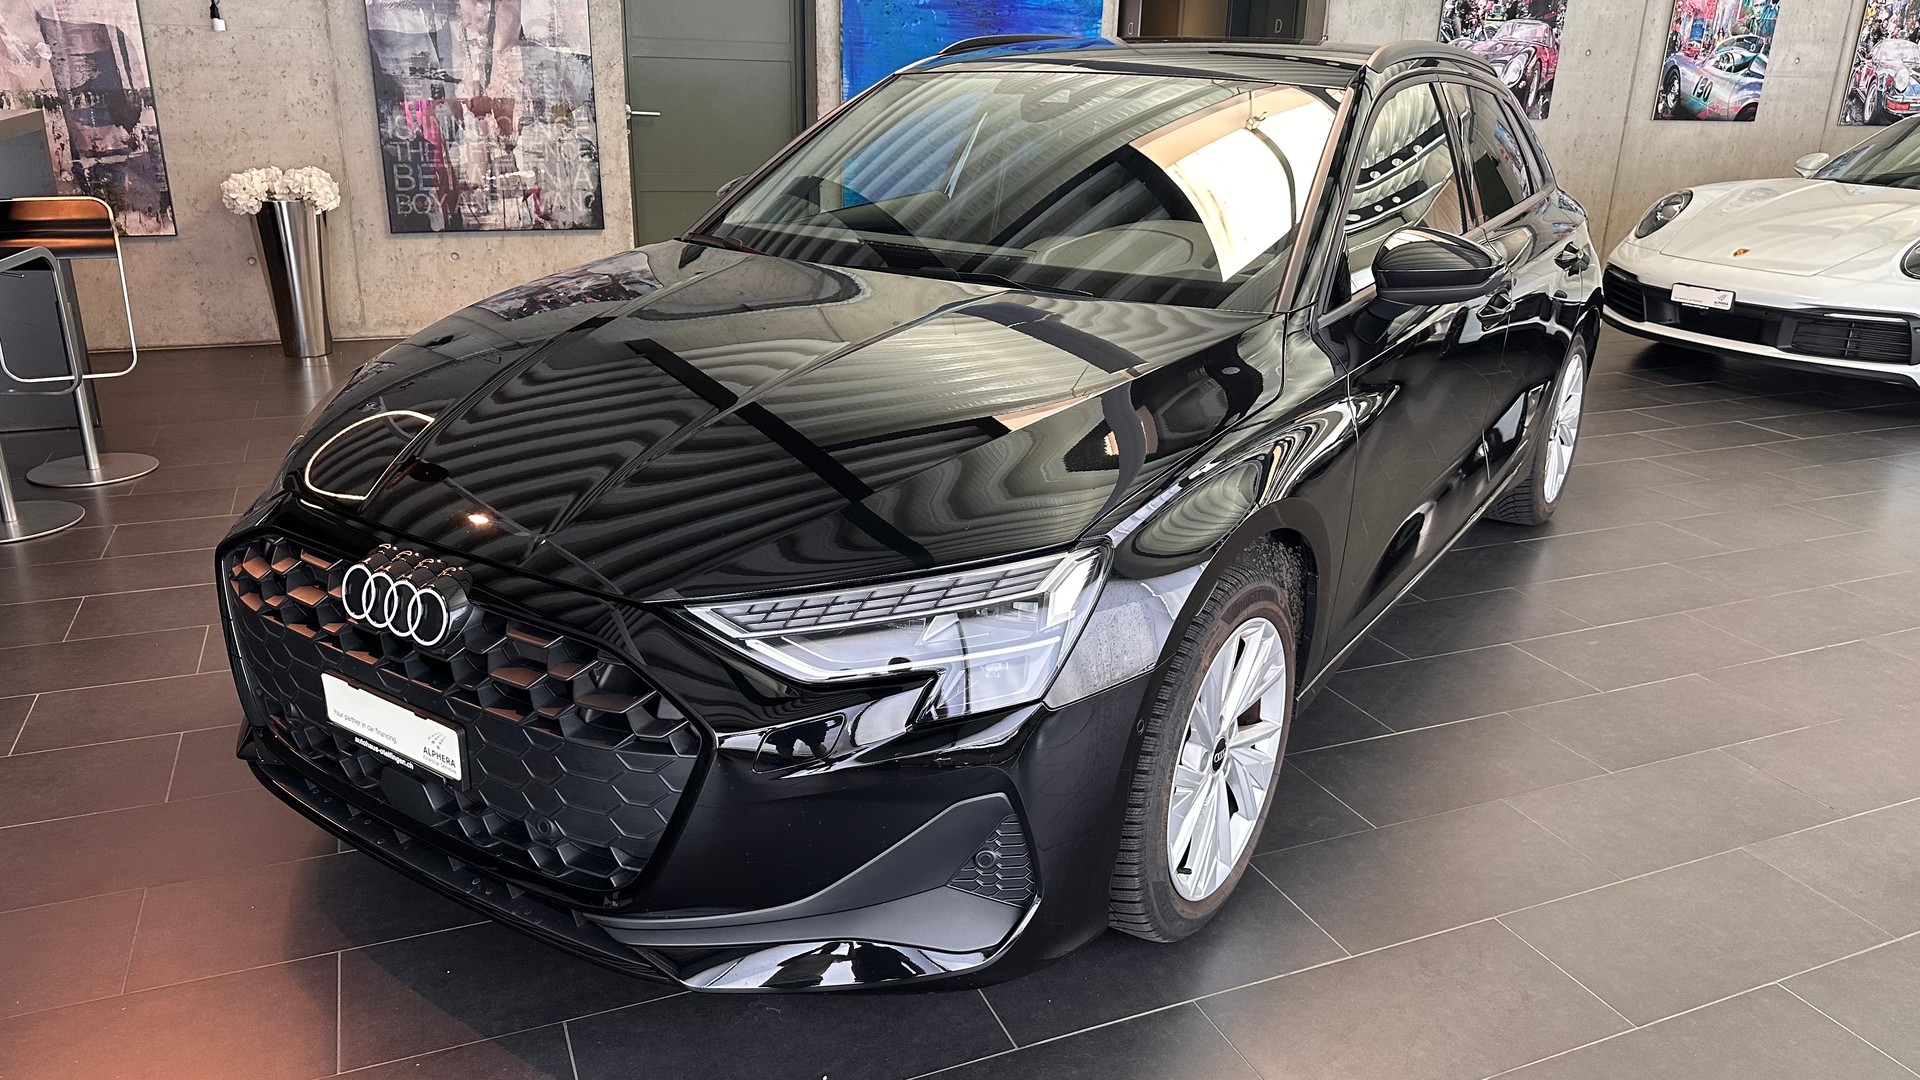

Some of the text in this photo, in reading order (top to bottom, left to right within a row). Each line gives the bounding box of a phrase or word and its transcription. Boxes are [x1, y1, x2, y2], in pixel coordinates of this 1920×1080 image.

[1692, 75, 1713, 102] 130
[389, 140, 441, 162] THE
[393, 161, 595, 191] BETWEN A
[395, 192, 448, 214] BOY
[333, 708, 343, 718] Your
[344, 714, 361, 726] partner
[423, 746, 456, 768] ALPHERA
